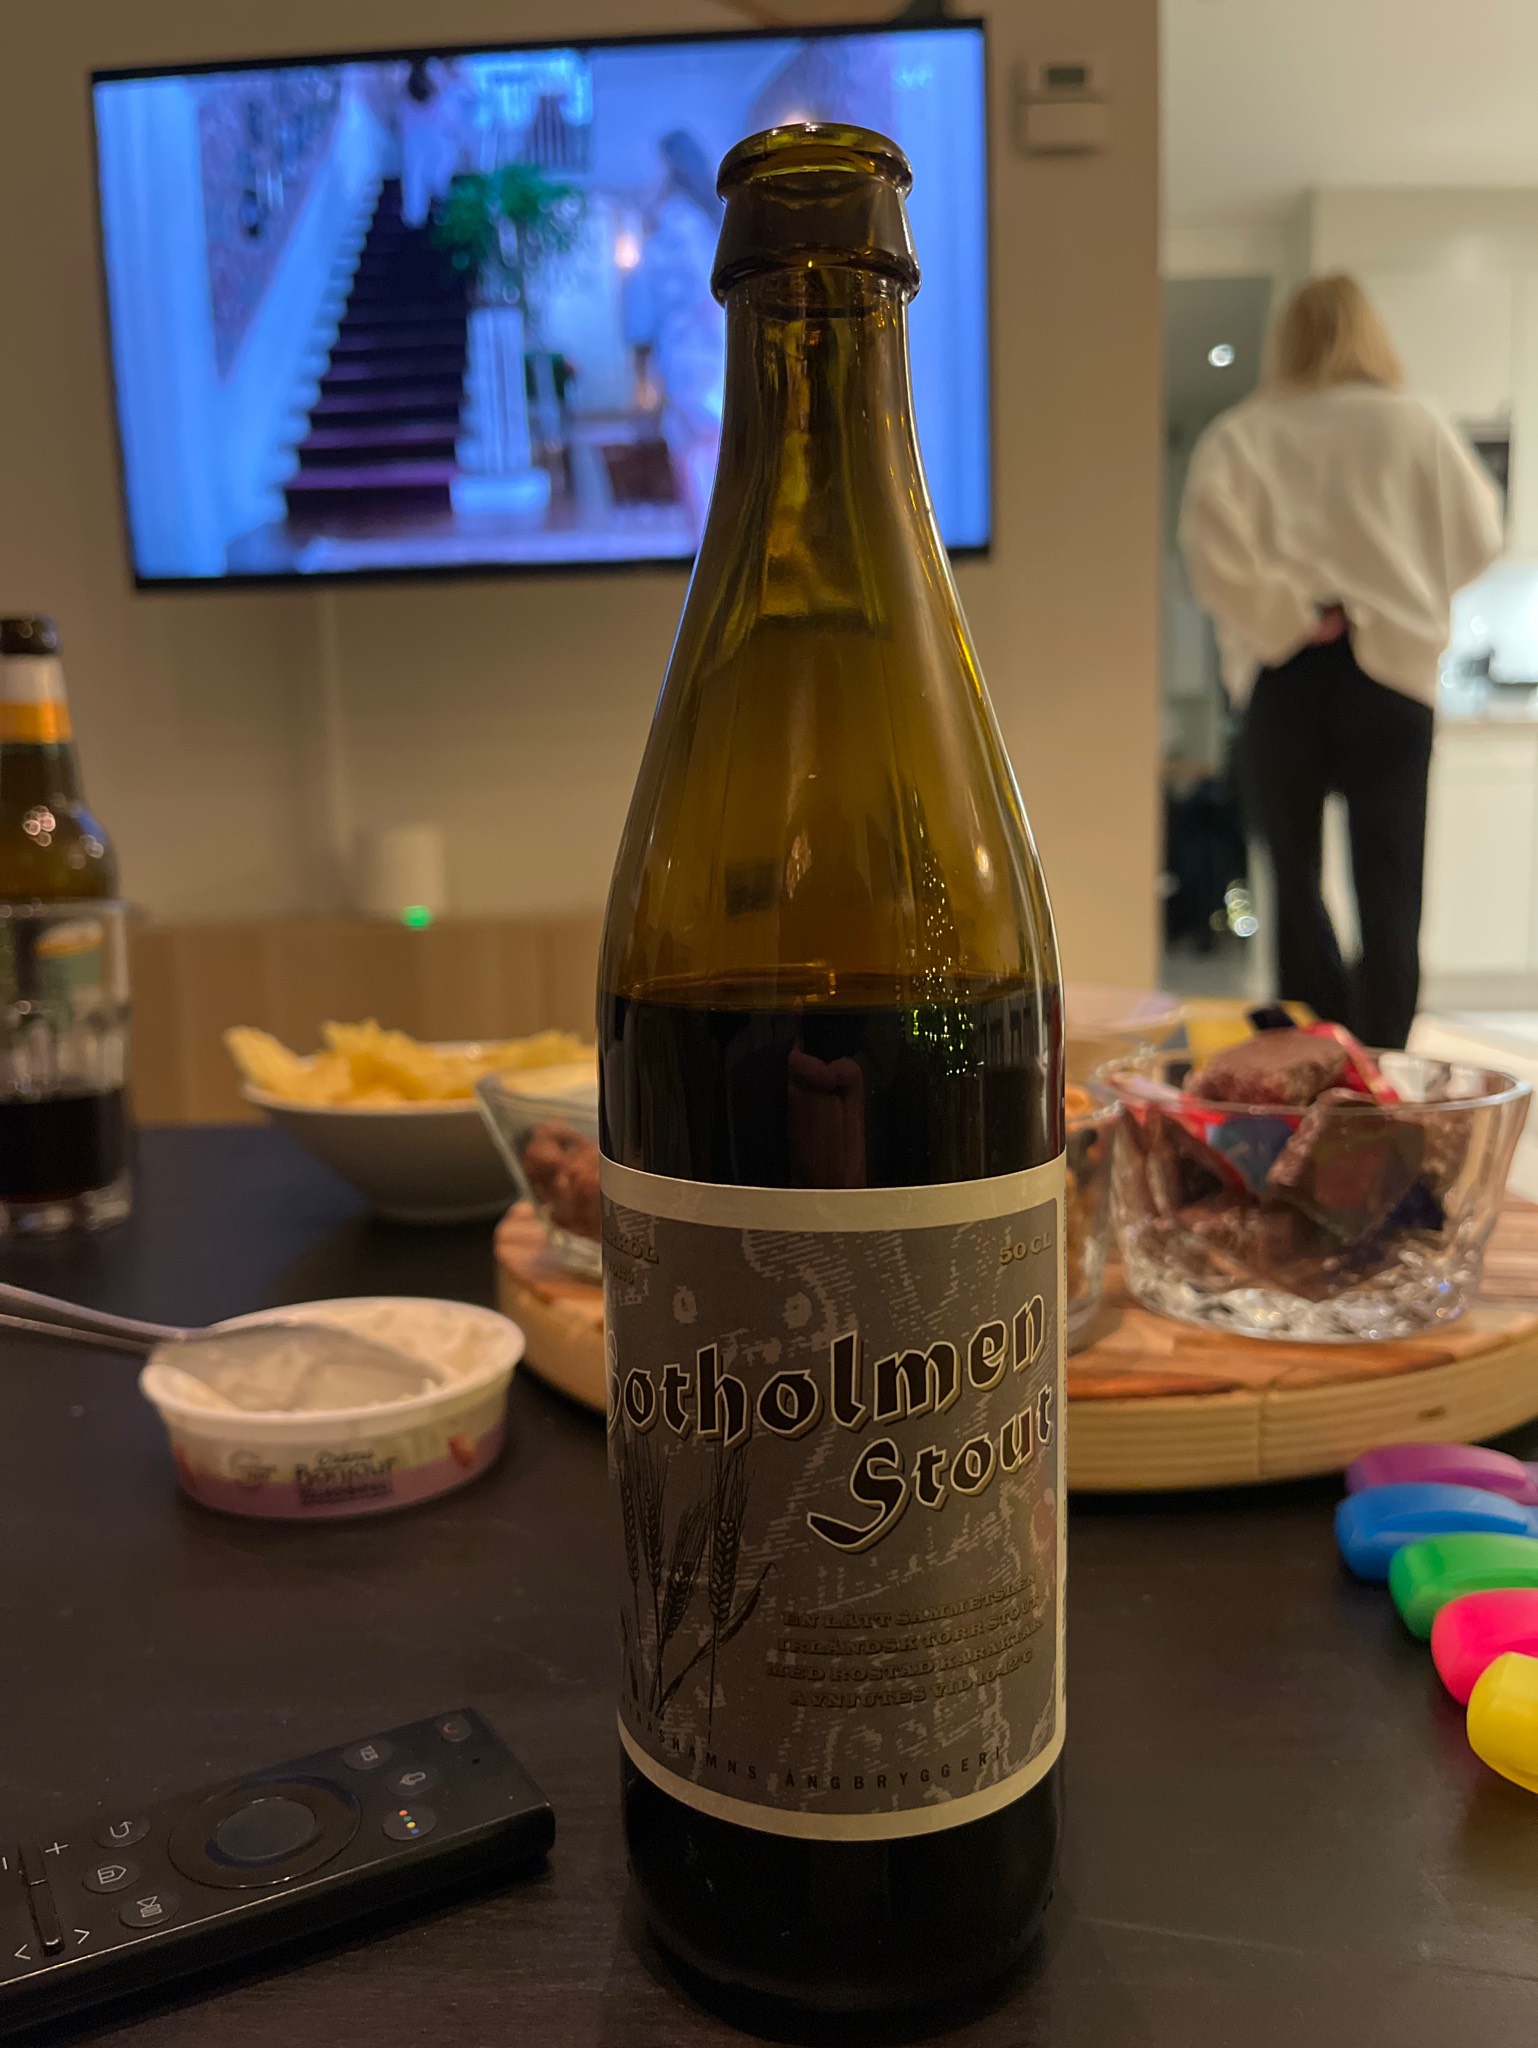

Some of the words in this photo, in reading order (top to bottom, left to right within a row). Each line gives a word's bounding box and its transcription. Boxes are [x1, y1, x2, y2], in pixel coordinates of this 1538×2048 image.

[999, 1241, 1028, 1265] 50
[1030, 1231, 1052, 1255] CL
[806, 1384, 1054, 1554] Stout
[930, 1679, 974, 1699] VID
[785, 1746, 1001, 1791] ÅNGBRYGGERI
